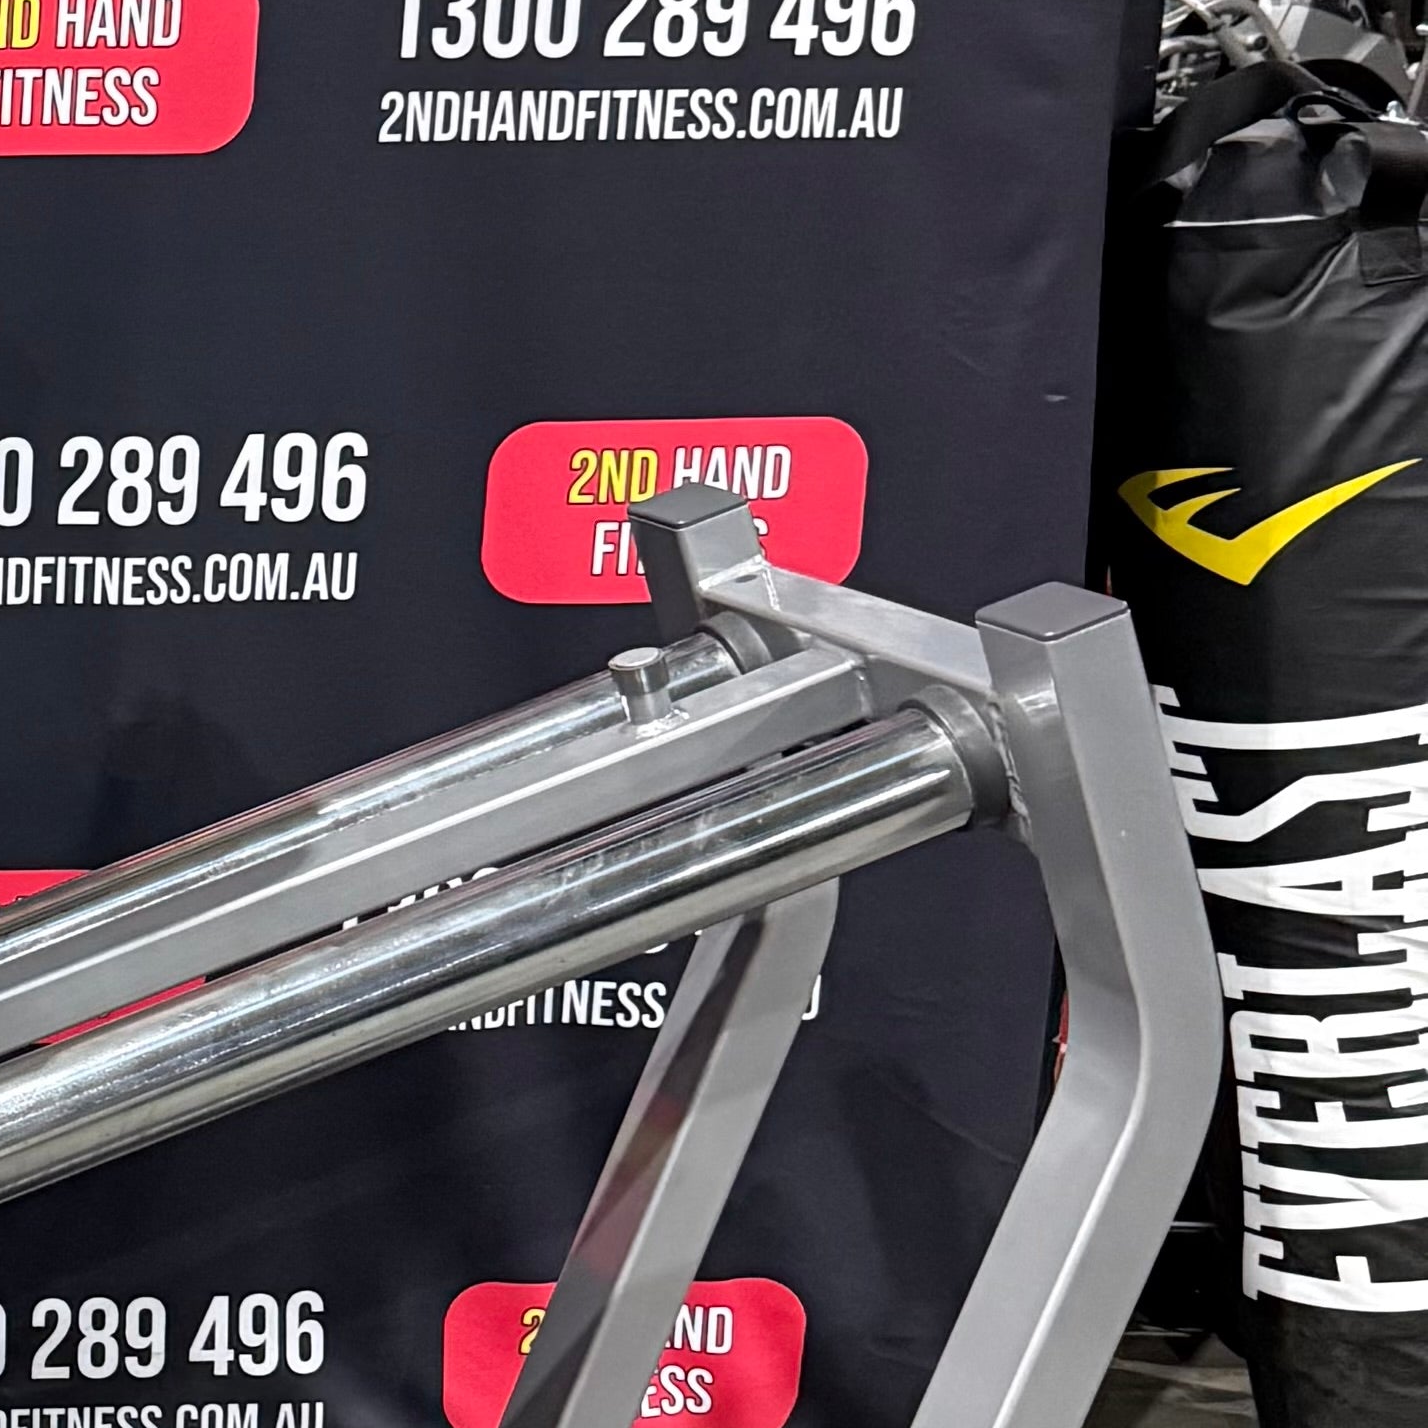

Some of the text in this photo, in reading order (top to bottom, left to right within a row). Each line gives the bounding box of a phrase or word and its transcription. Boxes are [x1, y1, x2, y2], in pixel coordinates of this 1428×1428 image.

[379, 88, 903, 142] 2NDHANDFITNESS.COM.AU
[58, 435, 199, 526] 289
[220, 432, 368, 522] 496
[568, 445, 791, 503] 2ND HAND
[32, 1297, 166, 1379] 289
[189, 1291, 323, 1376] 496
